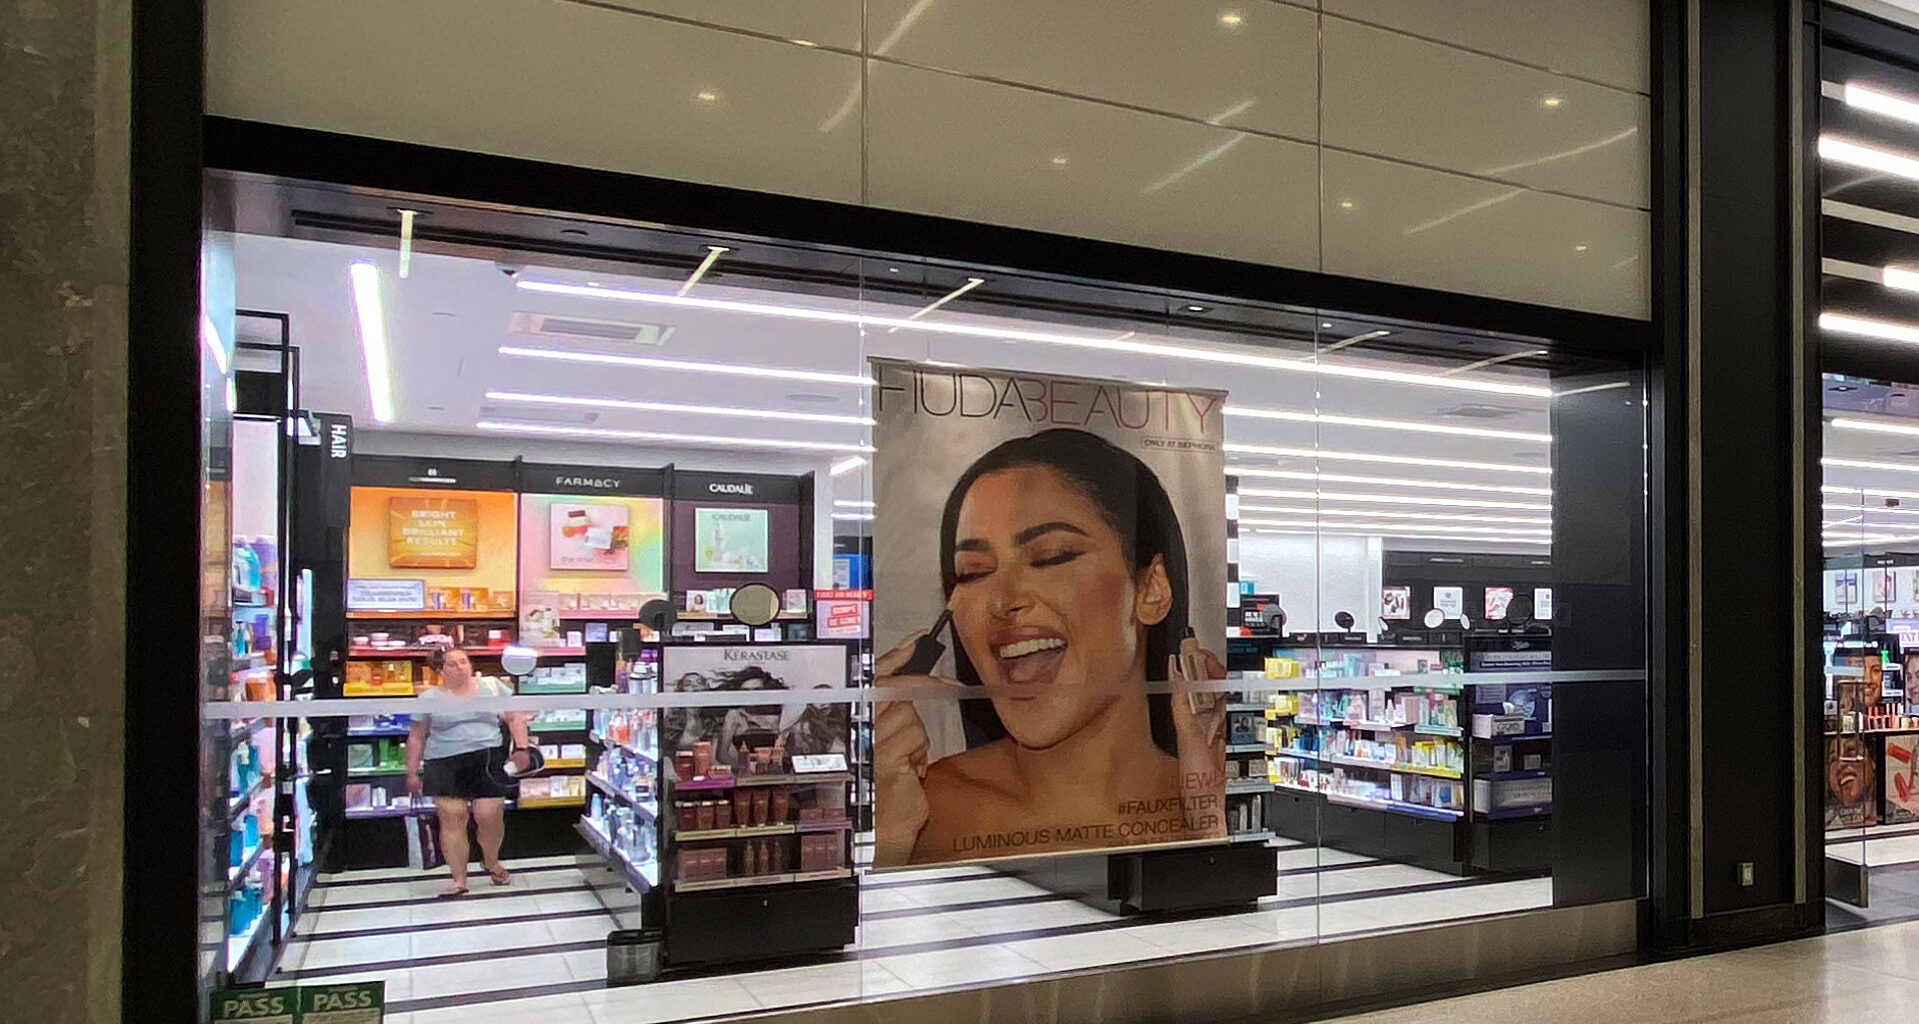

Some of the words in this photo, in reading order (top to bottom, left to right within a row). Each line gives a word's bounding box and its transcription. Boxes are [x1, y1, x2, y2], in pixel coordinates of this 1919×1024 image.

[331, 424, 347, 458] HAIR
[556, 477, 621, 488] FARMACY
[1118, 794, 1218, 815] #FAUXFILTER
[953, 829, 1049, 851] LUMINOUS
[1056, 824, 1114, 842] MATTE
[1118, 815, 1218, 837] CONCEALER
[223, 996, 285, 1018] PASS
[314, 991, 372, 1011] PASS
